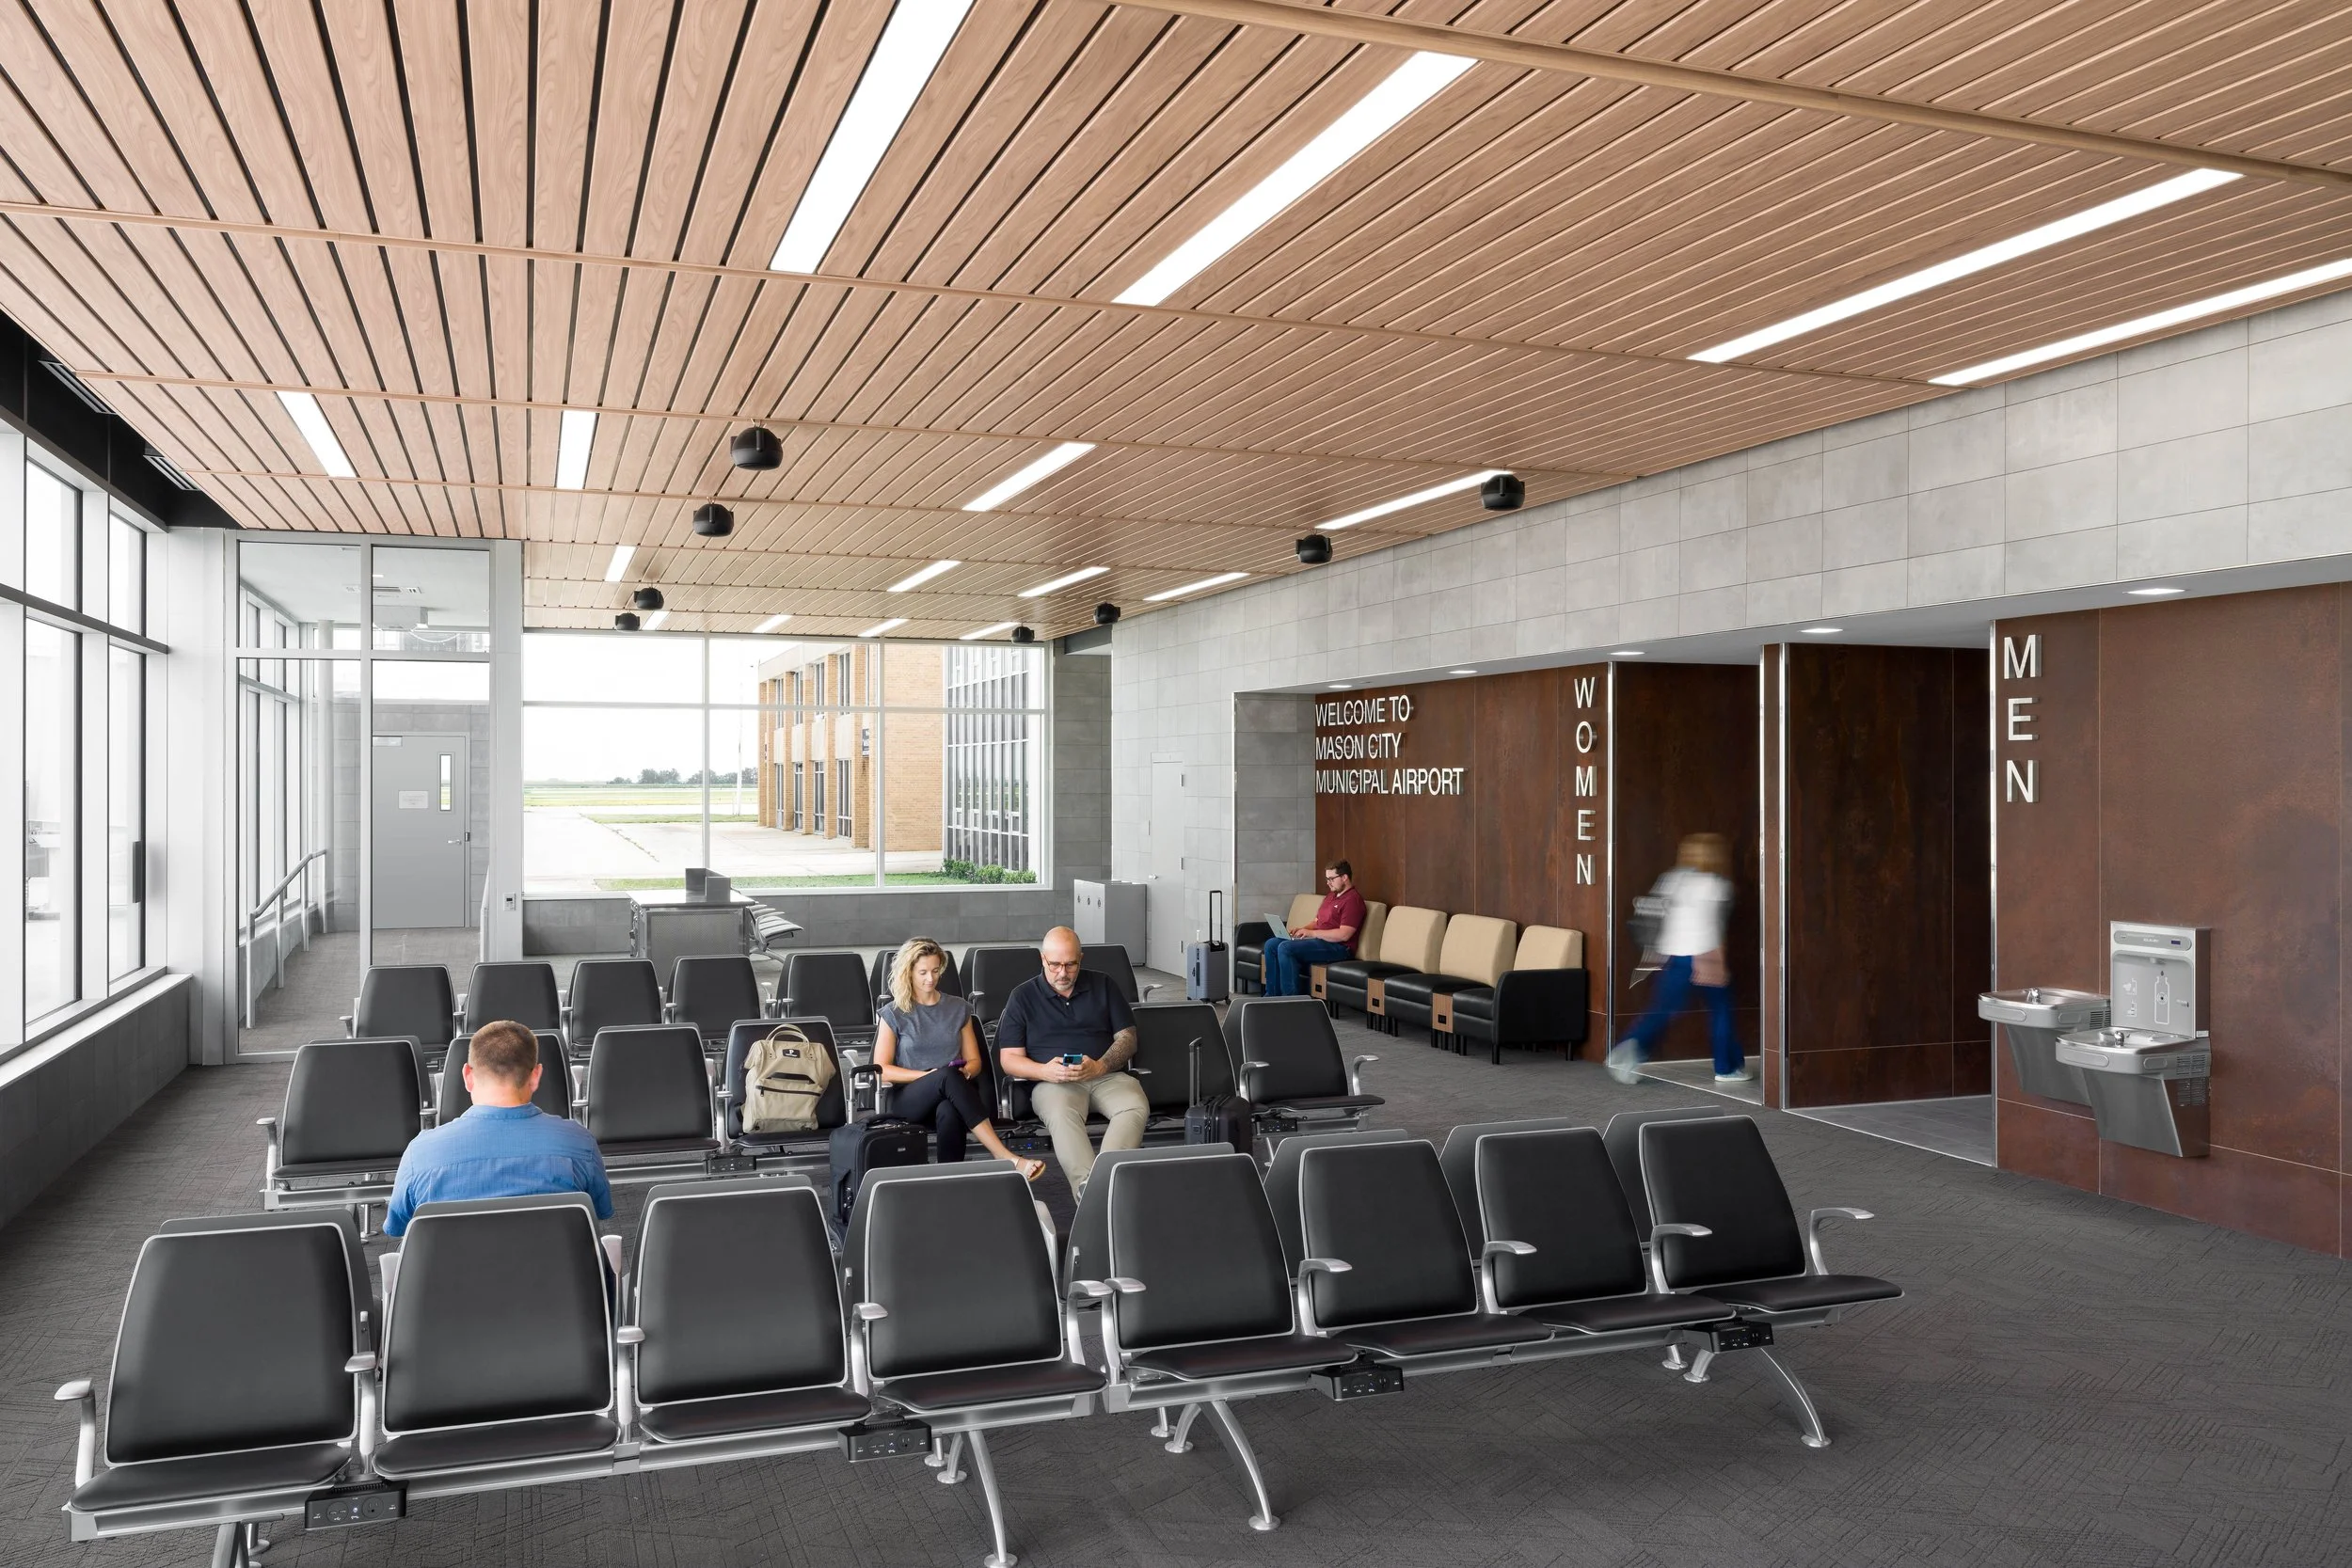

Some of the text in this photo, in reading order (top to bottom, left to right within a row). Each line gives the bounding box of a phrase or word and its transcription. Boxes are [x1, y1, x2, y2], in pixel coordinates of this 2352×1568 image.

[1315, 694, 1410, 726] WELCOME TO
[2003, 634, 2041, 803] MEN
[1315, 733, 1402, 760] MASON CITY
[1315, 768, 1464, 795] MUNICIPAL AIRPORT
[1574, 677, 1596, 885] WOMEN
